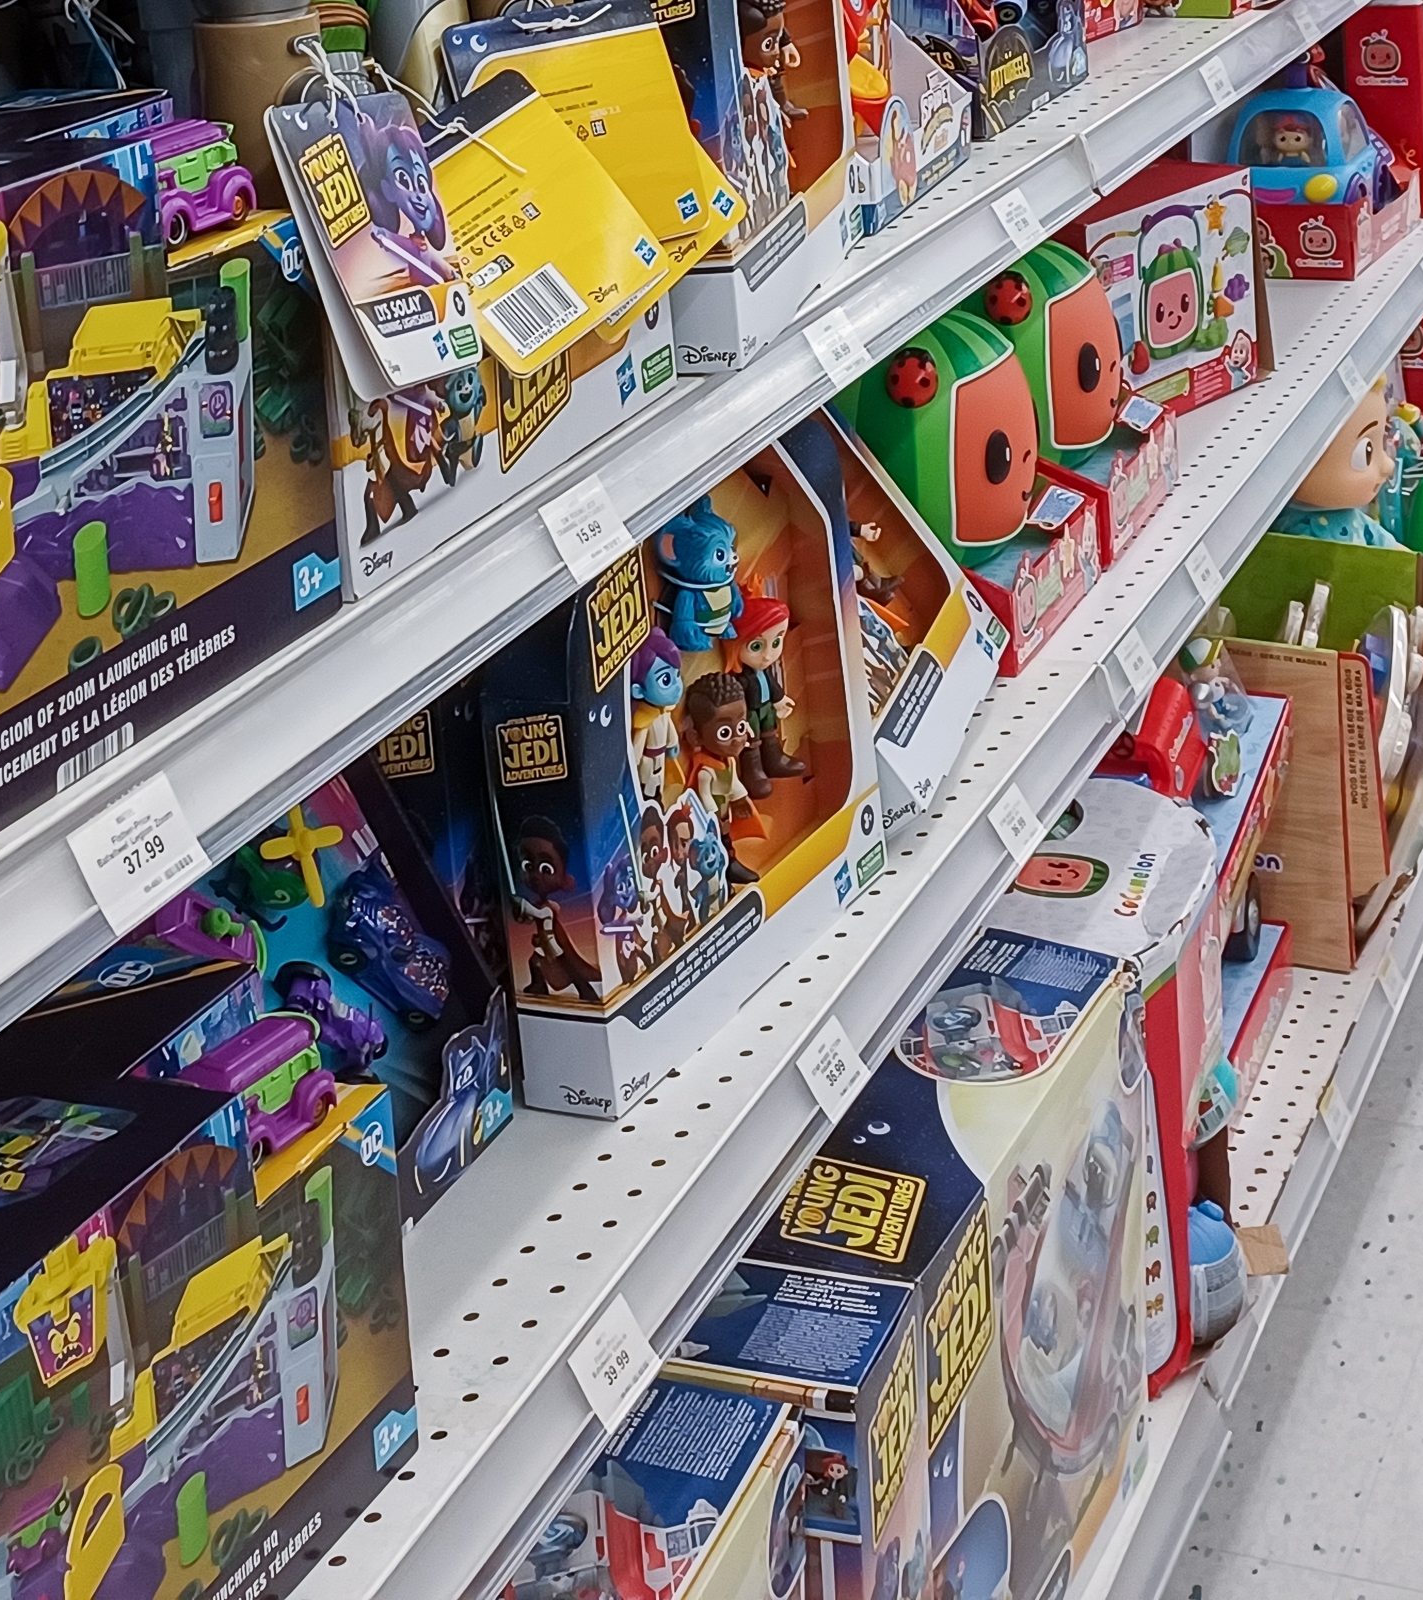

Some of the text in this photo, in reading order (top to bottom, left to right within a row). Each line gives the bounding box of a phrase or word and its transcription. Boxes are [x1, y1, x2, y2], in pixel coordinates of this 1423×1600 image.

[304, 144, 345, 185] YOUNG
[316, 167, 358, 220] JEDI
[281, 247, 304, 274] DC
[374, 294, 422, 322] LYS SOLAY
[678, 345, 738, 365] Disney
[505, 373, 567, 458] ADVENTURES
[575, 520, 603, 545] 15.99
[296, 563, 325, 597] 3+
[589, 562, 640, 619] YOUNG
[594, 584, 644, 657] JEDI
[597, 618, 651, 681] ADVENTURES
[37, 704, 55, 729] OF
[58, 679, 96, 717] ZOOM
[99, 635, 168, 693] LAUNCHING
[171, 622, 189, 648] HQ
[62, 721, 80, 749] DE
[83, 712, 100, 735] LA
[103, 677, 148, 726] LÉGION
[151, 663, 175, 693] DES
[500, 721, 558, 743] YOUNG
[504, 738, 560, 769] JEDI
[506, 763, 565, 782] ADVENTURES
[123, 835, 165, 875] 37.99
[99, 961, 153, 987] DC
[824, 1058, 846, 1089] 36.99
[560, 1084, 613, 1113] Disney
[790, 1165, 842, 1235] YOUNG
[826, 1172, 893, 1248] JEDI
[875, 1179, 917, 1256] ADVENTURES
[930, 1260, 988, 1403] JEDI
[603, 1349, 631, 1386] 39.99
[378, 1421, 403, 1457] 3+
[263, 1529, 280, 1558] HQ
